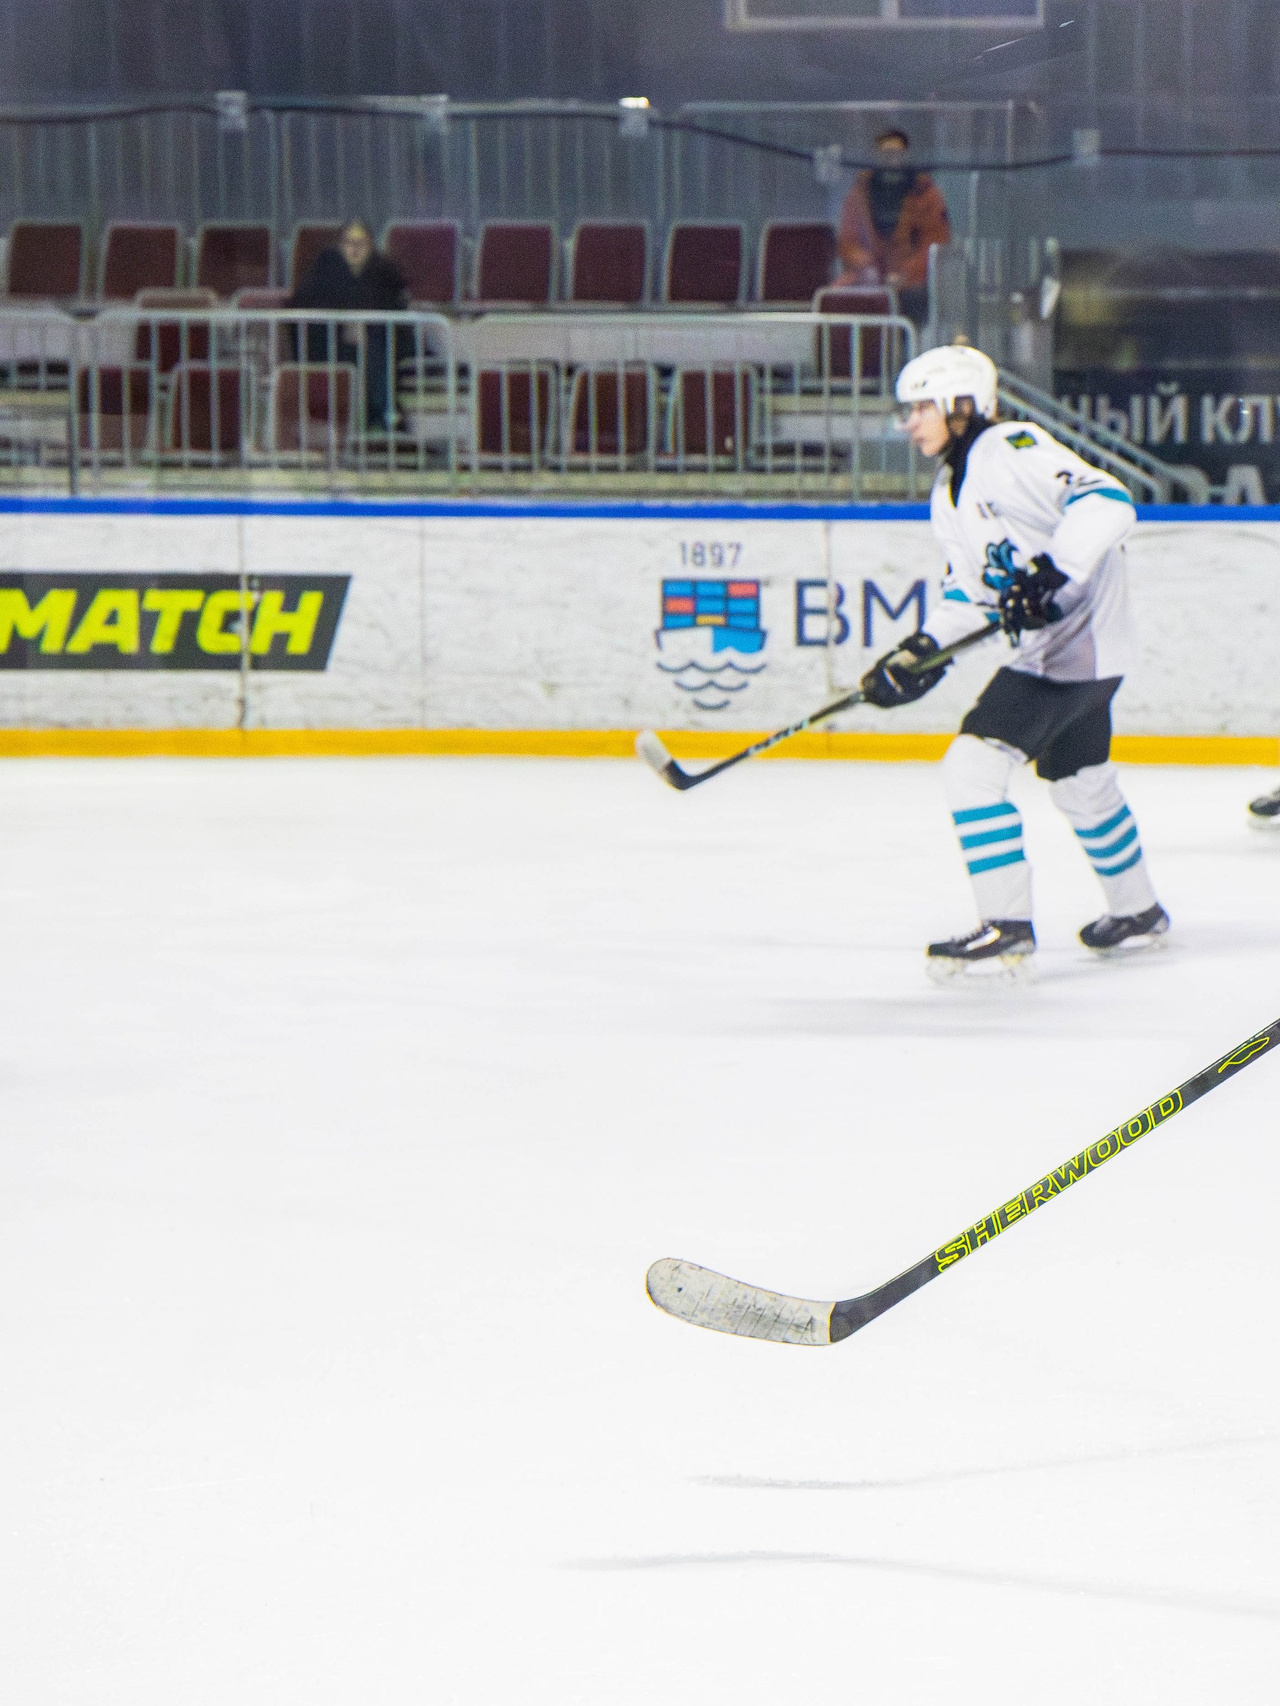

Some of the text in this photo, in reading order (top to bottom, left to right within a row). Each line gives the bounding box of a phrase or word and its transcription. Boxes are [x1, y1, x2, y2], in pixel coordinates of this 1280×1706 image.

[679, 542, 743, 568] 1897
[0, 587, 325, 655] MATCH
[934, 1088, 1183, 1273] SHERWOOD
